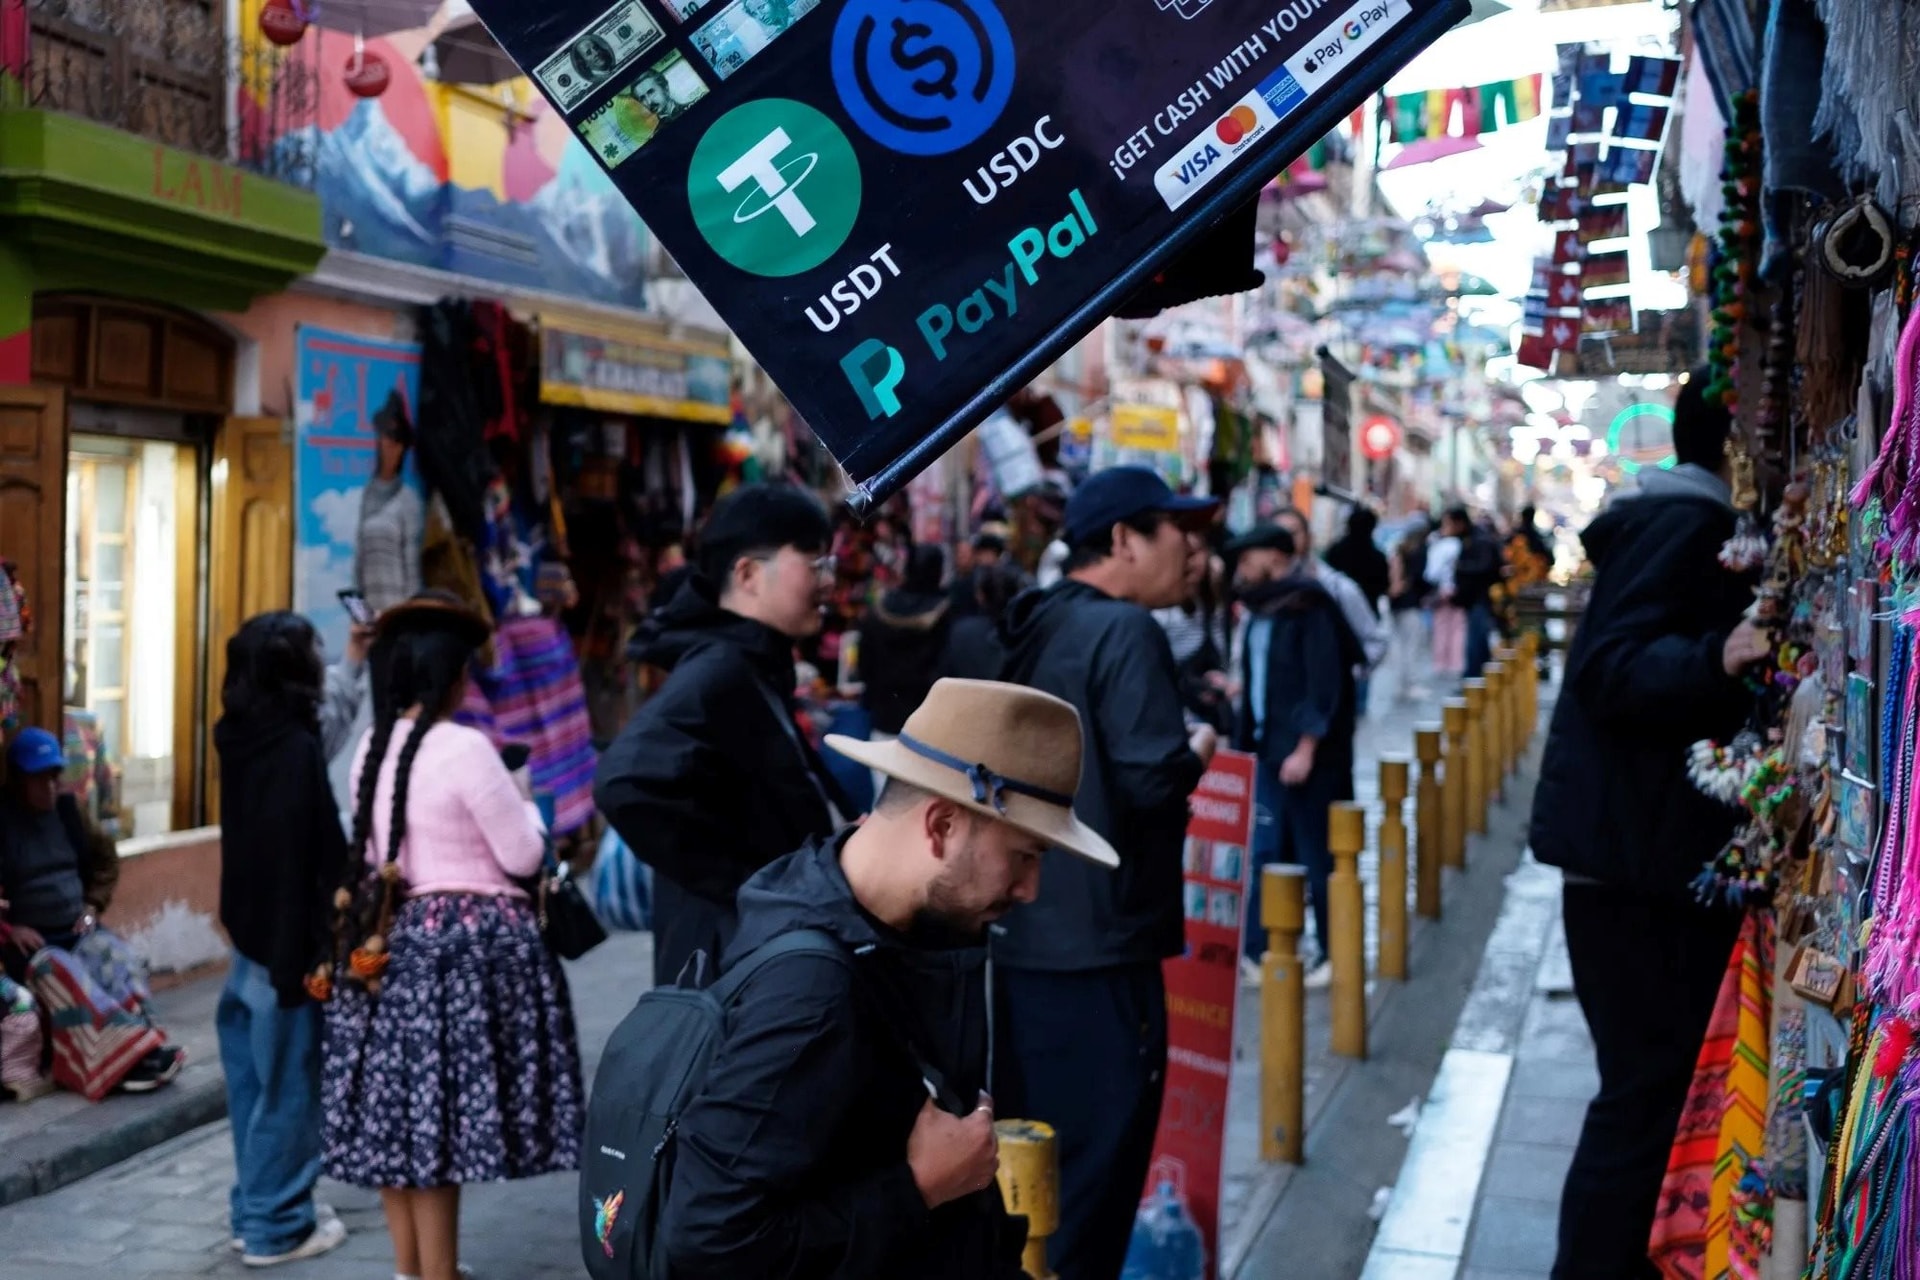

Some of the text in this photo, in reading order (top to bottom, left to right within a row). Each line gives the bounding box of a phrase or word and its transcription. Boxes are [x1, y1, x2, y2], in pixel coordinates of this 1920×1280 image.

[1360, 0, 1389, 28] Pay
[1313, 38, 1344, 65] Pay
[1154, 80, 1211, 136] CASH
[1205, 34, 1267, 90] WITH
[1263, 75, 1294, 101] AMERICAN
[963, 114, 1065, 205] USDC
[1231, 125, 1265, 155] mastercard
[1170, 143, 1221, 185] VISA
[804, 243, 901, 333] USDT
[915, 188, 1099, 362] PayPal
